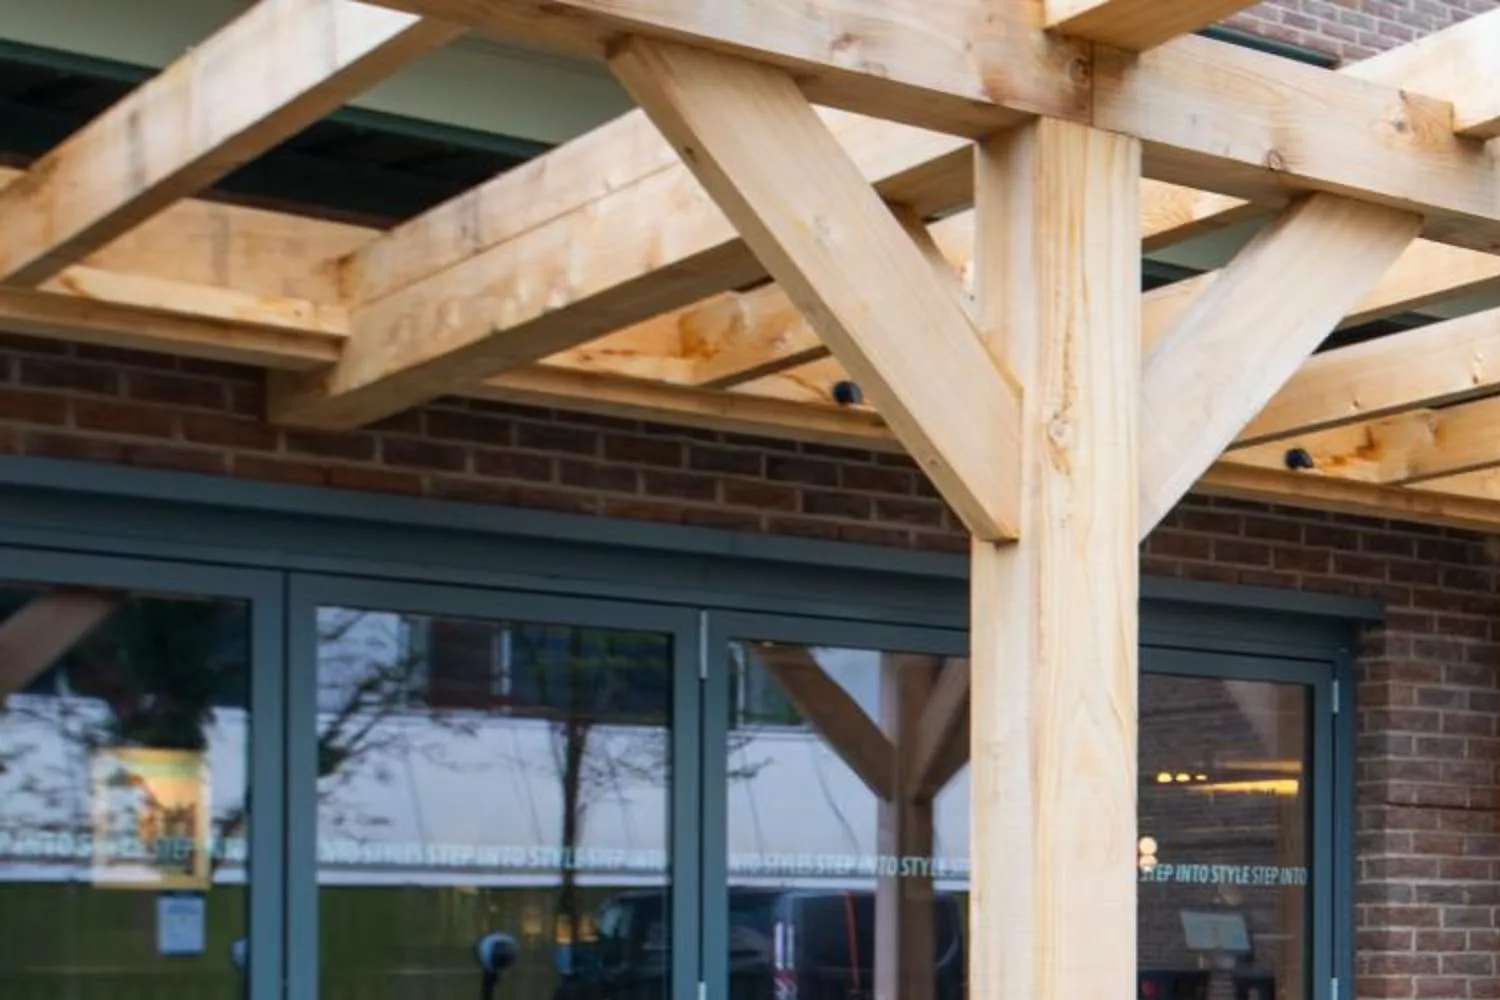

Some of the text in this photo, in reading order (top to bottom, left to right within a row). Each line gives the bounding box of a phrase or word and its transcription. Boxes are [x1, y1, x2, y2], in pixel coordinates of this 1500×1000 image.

[1175, 864, 1208, 883] INTO
[1210, 864, 1250, 885] STYLE
[1252, 866, 1279, 885] STEP
